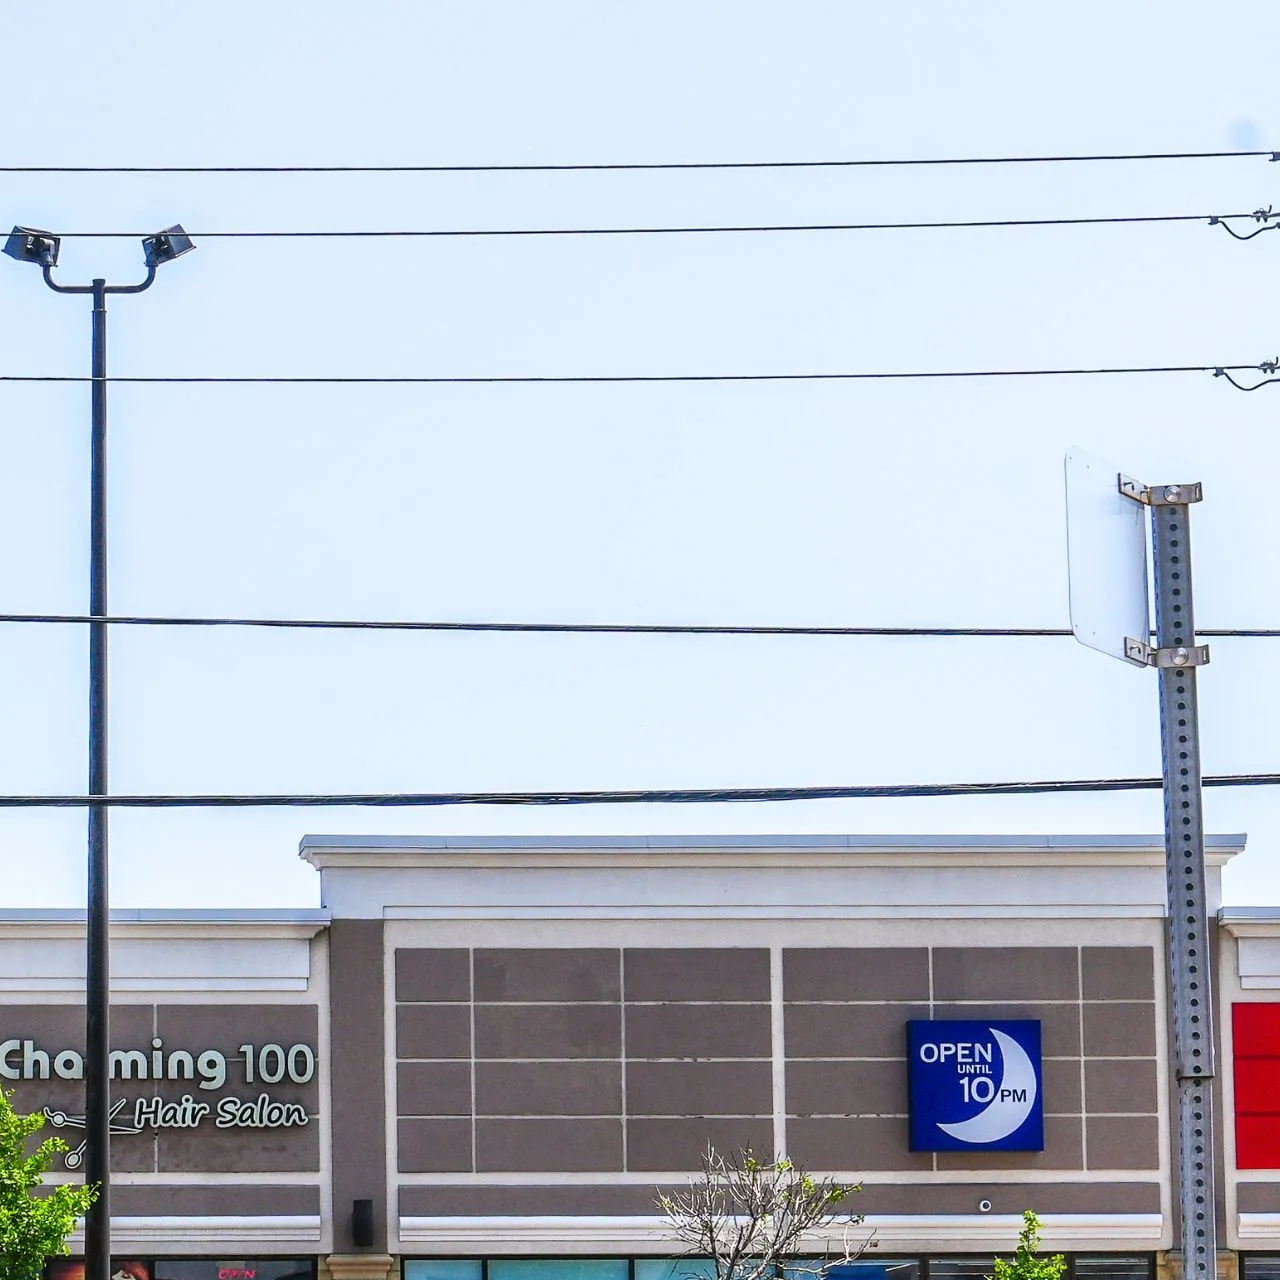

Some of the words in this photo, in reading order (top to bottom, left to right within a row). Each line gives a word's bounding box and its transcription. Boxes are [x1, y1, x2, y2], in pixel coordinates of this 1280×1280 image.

[238, 1043, 315, 1084] 100
[920, 1043, 992, 1063] OPEN
[957, 1064, 993, 1074] UNTIL
[959, 1076, 995, 1103] 10
[1000, 1089, 1027, 1103] PM
[134, 1094, 210, 1128] Hair
[216, 1093, 308, 1128] Salon
